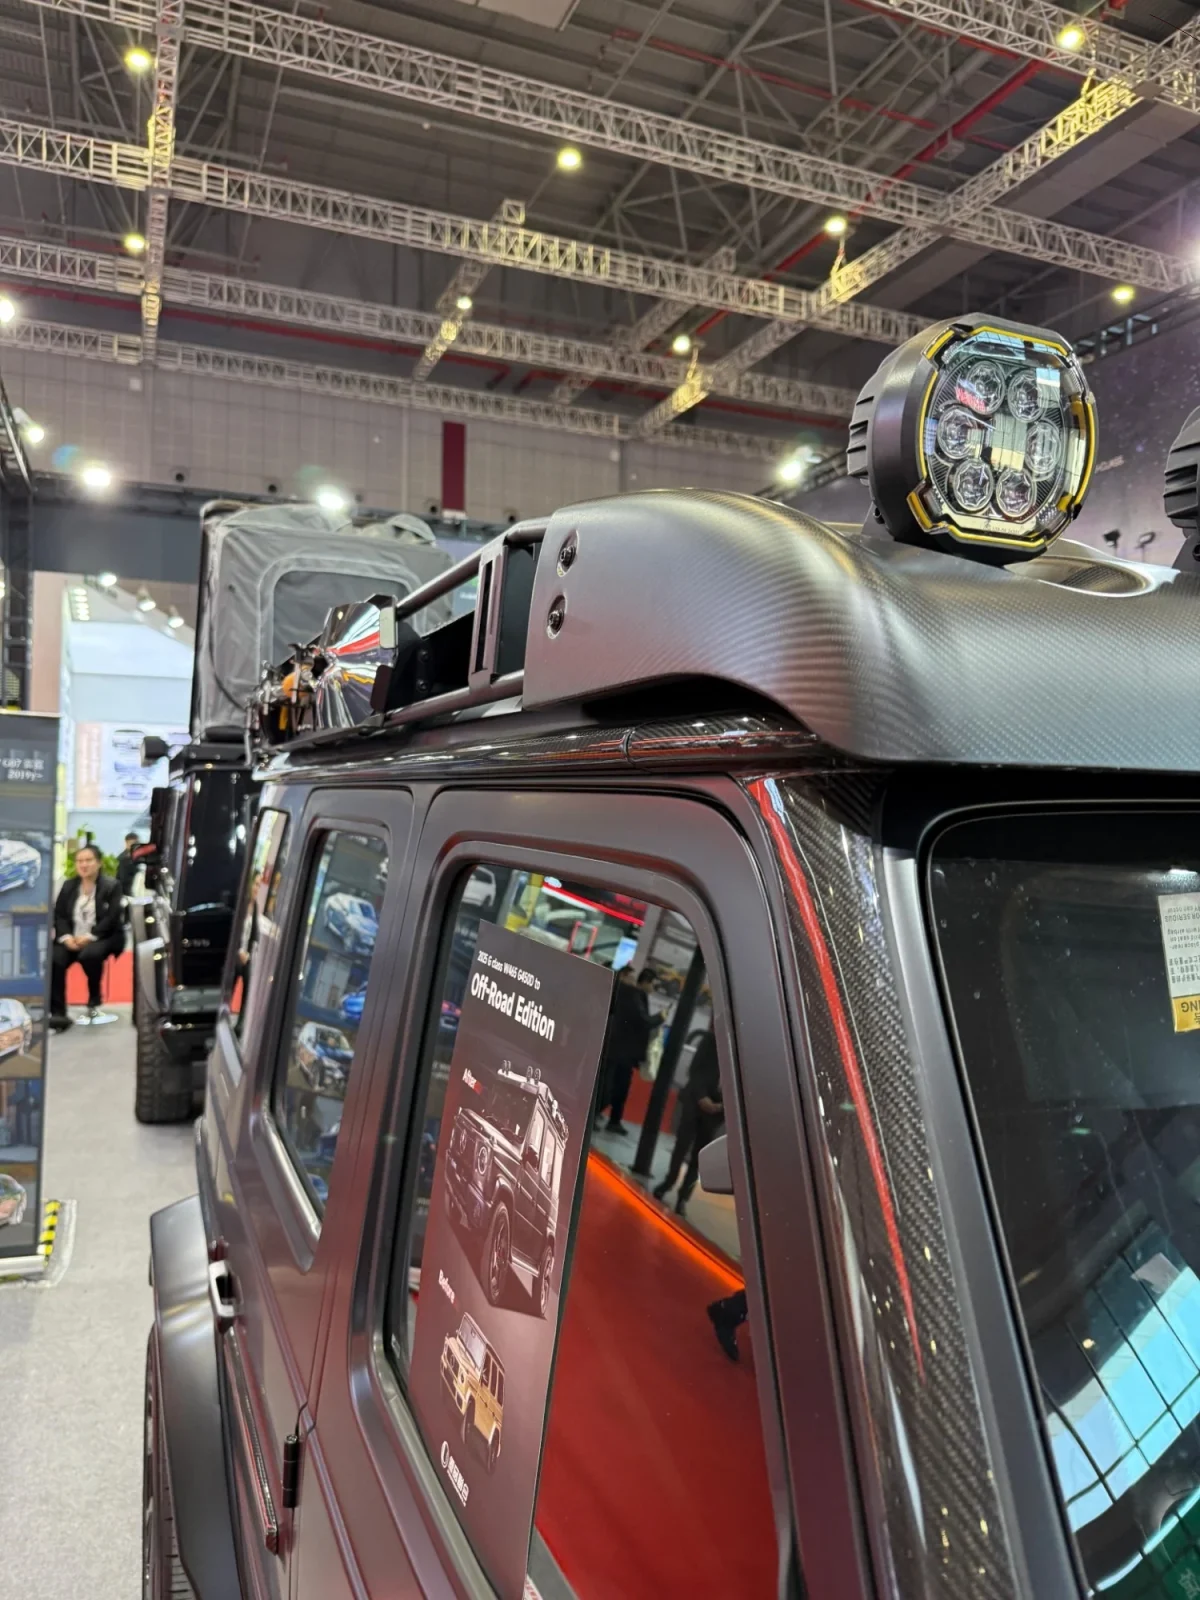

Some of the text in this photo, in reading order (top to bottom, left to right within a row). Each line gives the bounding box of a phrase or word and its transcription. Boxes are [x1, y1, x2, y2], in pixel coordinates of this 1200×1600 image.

[1164, 914, 1191, 923] SERIOUS
[487, 955, 493, 967] G
[491, 956, 503, 973] class
[503, 962, 517, 979] W465
[534, 978, 541, 990] to
[470, 972, 556, 1041] Off-Road Edition
[461, 1067, 477, 1090] After
